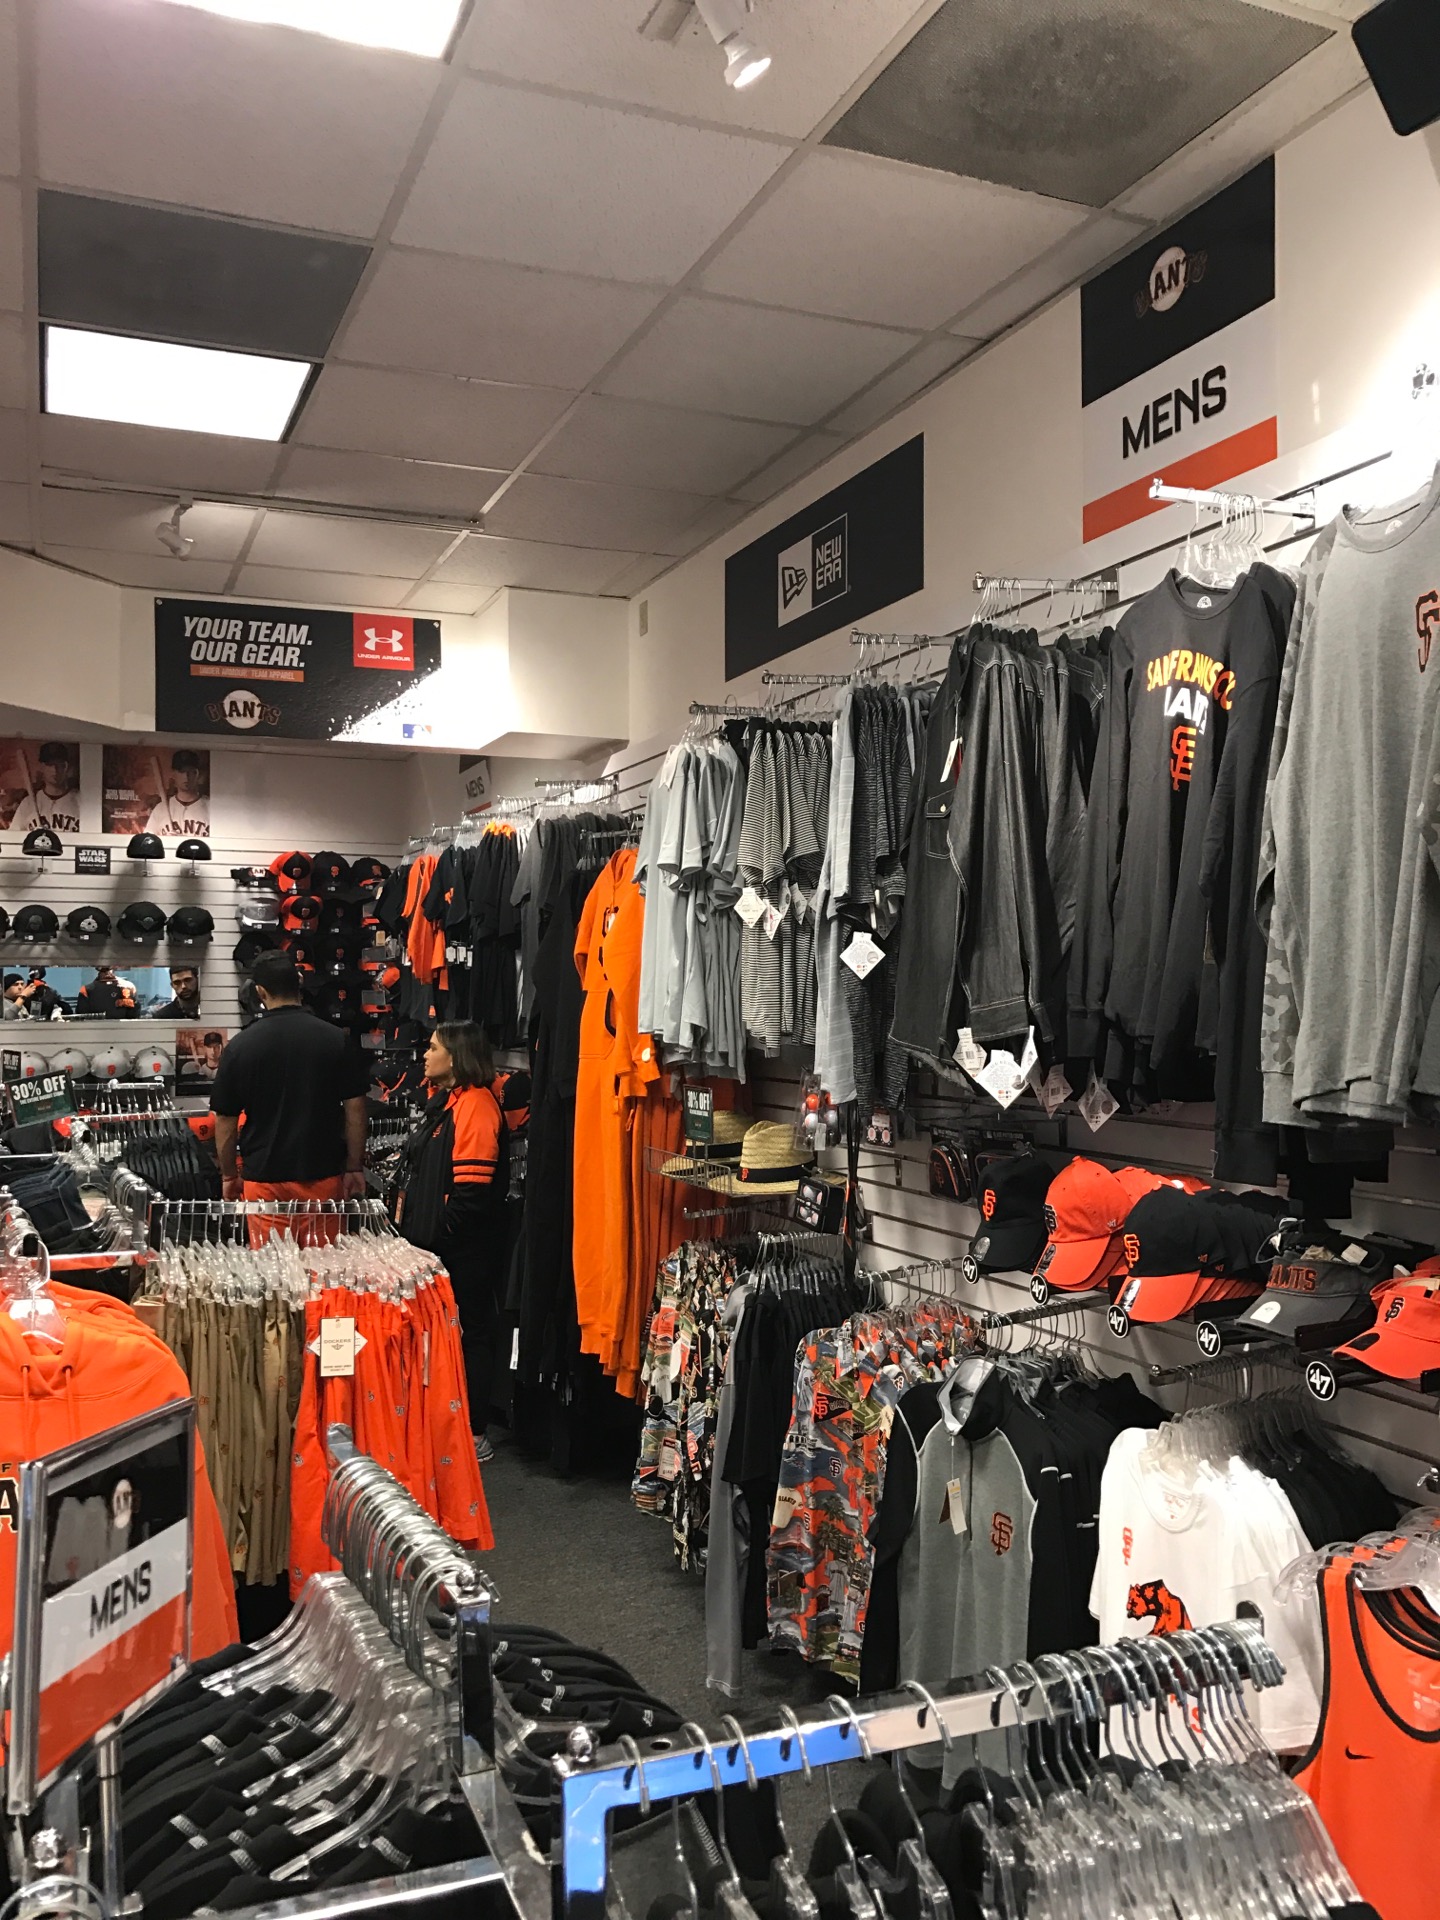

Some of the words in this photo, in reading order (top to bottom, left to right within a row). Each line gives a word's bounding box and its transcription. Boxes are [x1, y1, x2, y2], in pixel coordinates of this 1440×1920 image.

[1122, 365, 1227, 459] MENS
[816, 534, 842, 569] NEW
[816, 558, 842, 590] ERA
[183, 616, 242, 641] YOUR
[247, 621, 313, 645] TEAM.
[191, 640, 237, 663] OUR
[242, 643, 305, 667] GEAR.
[204, 701, 281, 725] GIANTS
[465, 776, 485, 800] MENS
[78, 849, 107, 857] STAR
[78, 855, 107, 863] WARS
[11, 1081, 41, 1100] 30%
[43, 1075, 66, 1093] OFF
[89, 1560, 153, 1639] MENS
